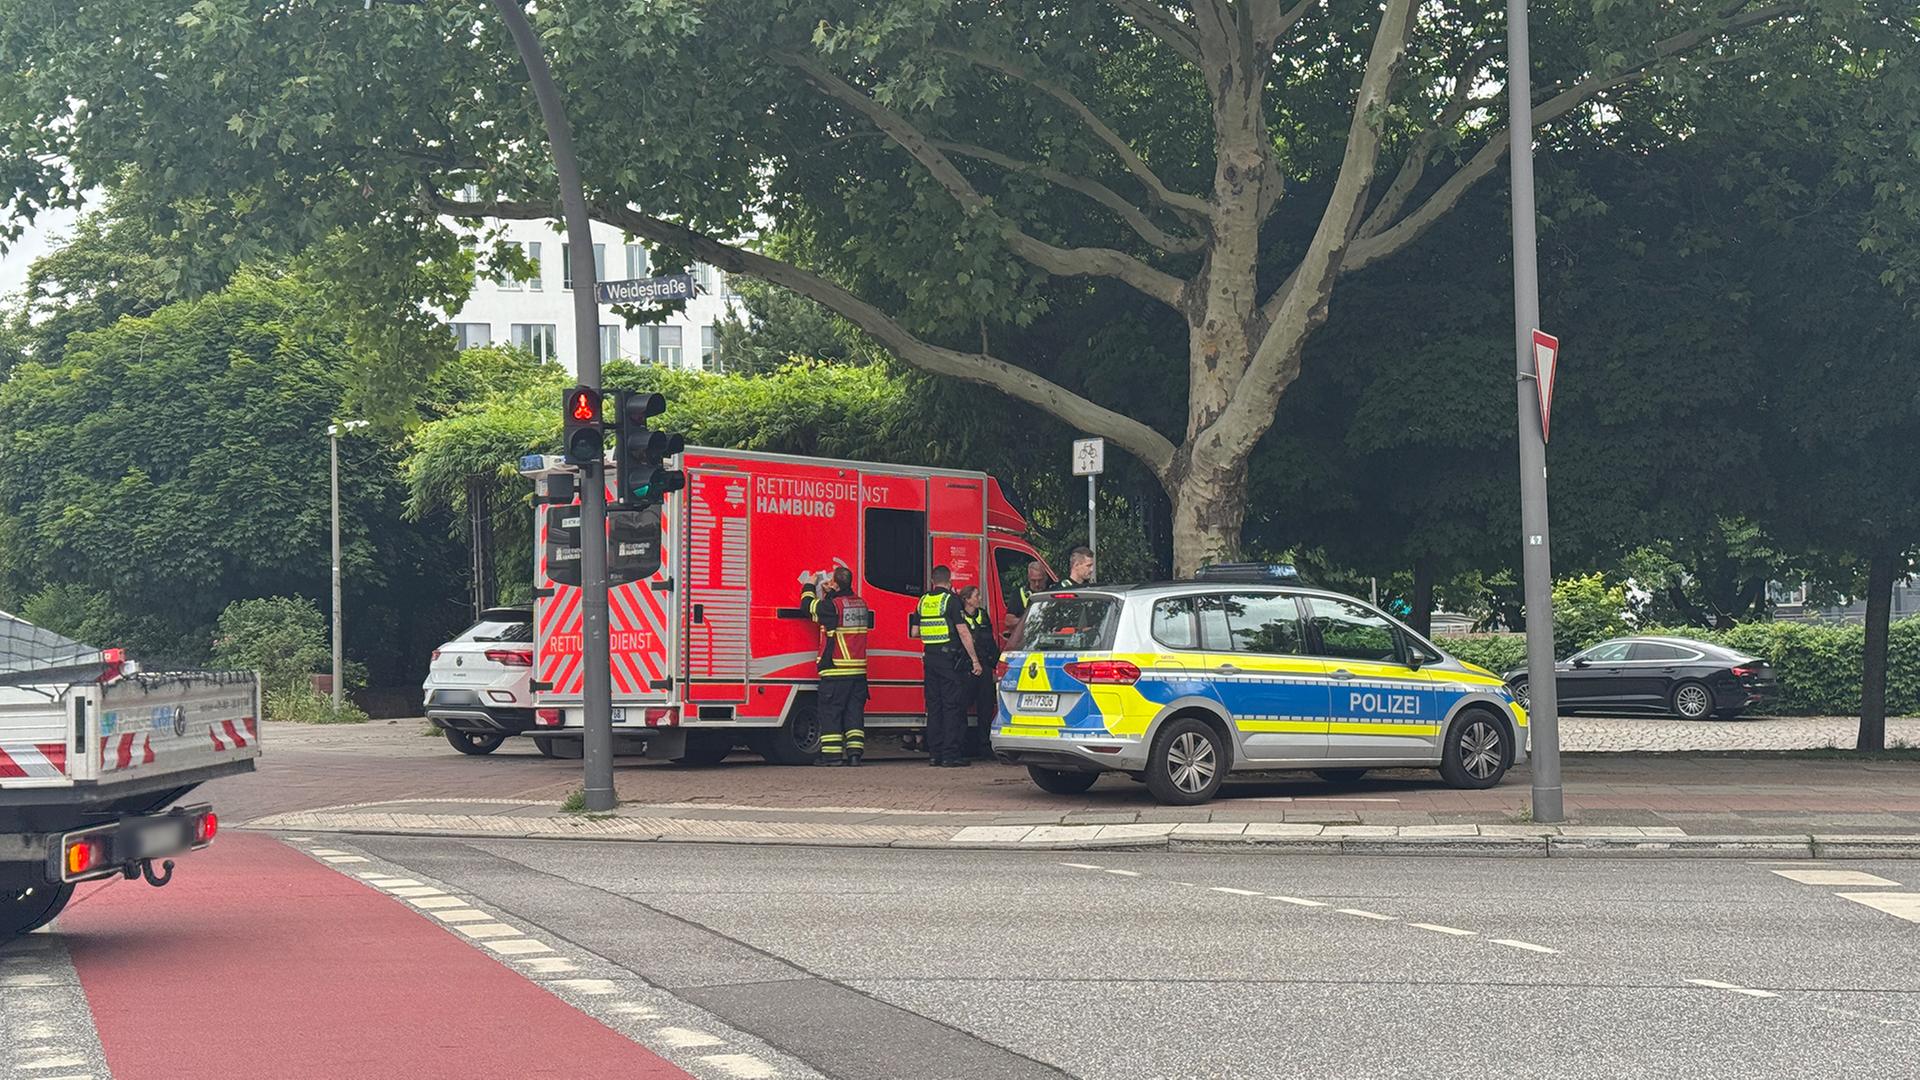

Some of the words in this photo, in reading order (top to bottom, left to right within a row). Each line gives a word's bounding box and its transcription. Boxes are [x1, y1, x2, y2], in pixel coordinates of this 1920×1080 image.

[606, 279, 687, 299] Weidestraße
[756, 476, 889, 504] RETTUNGSDIENST
[756, 496, 836, 518] HAMBURG
[550, 632, 653, 652] RETTUDIENST
[1349, 692, 1420, 715] POLIZEI
